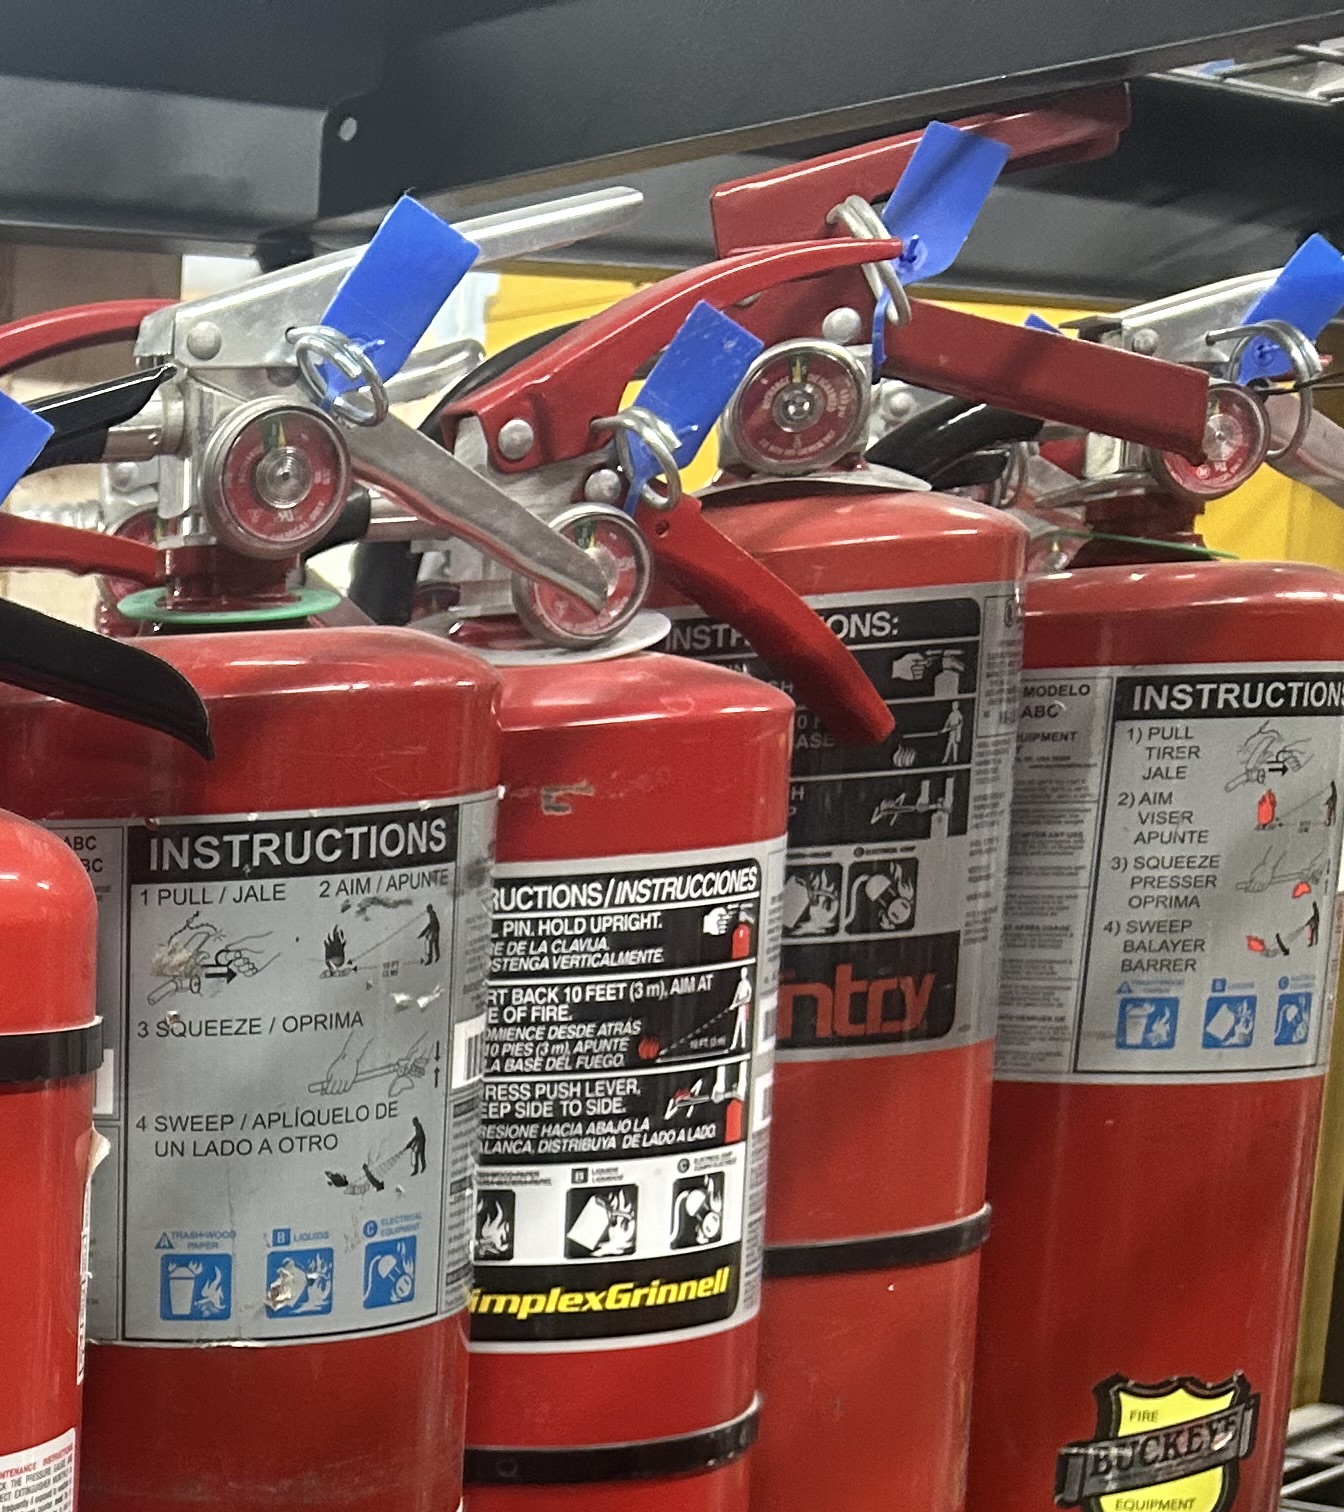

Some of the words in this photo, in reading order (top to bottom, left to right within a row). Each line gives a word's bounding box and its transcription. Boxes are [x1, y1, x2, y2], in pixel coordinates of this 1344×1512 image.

[1021, 704, 1060, 718] ABC
[1127, 727, 1142, 742] 1)
[1148, 726, 1194, 741] PULL
[1146, 746, 1200, 760] TIRER
[1142, 766, 1187, 779] JALE
[1118, 792, 1136, 806] 2)
[1139, 792, 1173, 805] AIM
[1138, 811, 1193, 824] VISER
[1134, 830, 1209, 844] APUNTE
[149, 819, 447, 872] INSTRUCTIONS
[1111, 856, 1128, 870] 3)
[1133, 855, 1221, 869] SQUEEZE
[319, 881, 330, 899] 2
[336, 877, 373, 899] AIM
[386, 867, 449, 893] APUNTE
[1130, 875, 1218, 889] PRESSER
[140, 889, 148, 906] 1
[158, 886, 212, 906] PULL
[233, 883, 286, 903] JALE
[1129, 895, 1200, 909] OPRIMA
[503, 920, 534, 937] PIN.
[538, 917, 586, 935] HOLD
[590, 912, 662, 932] UPRIGHT.
[1103, 920, 1120, 935] 4)
[1126, 920, 1193, 934] SWEEP
[1123, 938, 1206, 953] BALAYER
[1121, 958, 1197, 972] BARRER
[138, 1022, 149, 1039] 3
[156, 1018, 261, 1039] SQUEEZE
[282, 1011, 363, 1034] OPRIMA
[155, 1138, 184, 1158] UN
[192, 1136, 252, 1157] LADO
[259, 1136, 272, 1155] A
[278, 1133, 338, 1154] OTRO
[1130, 1410, 1158, 1422] FIRE
[1116, 1498, 1196, 1511] EQUIPMENT
